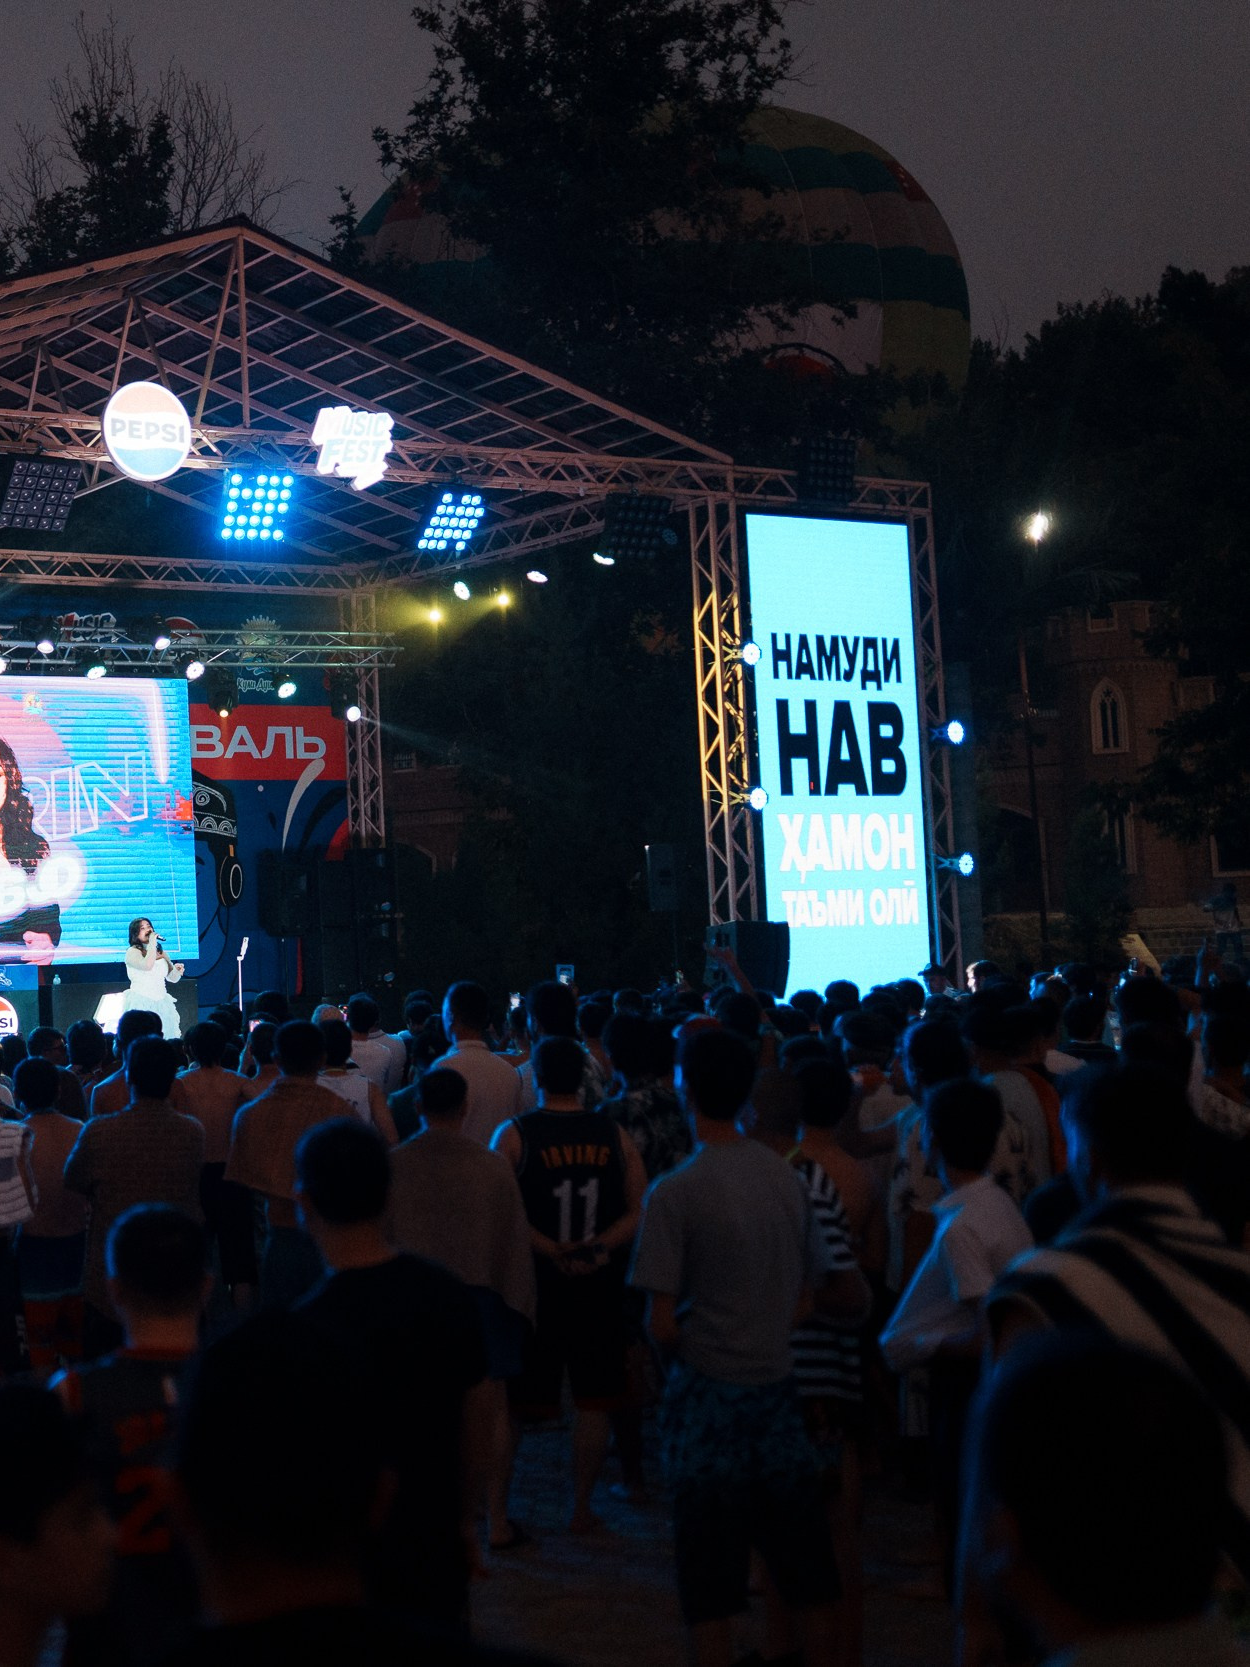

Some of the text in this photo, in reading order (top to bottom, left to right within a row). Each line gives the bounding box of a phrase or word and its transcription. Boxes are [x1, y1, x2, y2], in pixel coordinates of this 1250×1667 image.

[110, 417, 185, 444] PEPSI
[317, 412, 388, 438] MUSIC
[319, 438, 388, 468] FEST
[770, 632, 903, 691] НАМУДИ
[190, 724, 327, 760] ВАЛЬ
[775, 698, 908, 797] НАВ
[777, 812, 917, 884] ҲАМОН
[781, 888, 865, 928] ТАЪМИ
[551, 1177, 599, 1243] 11
